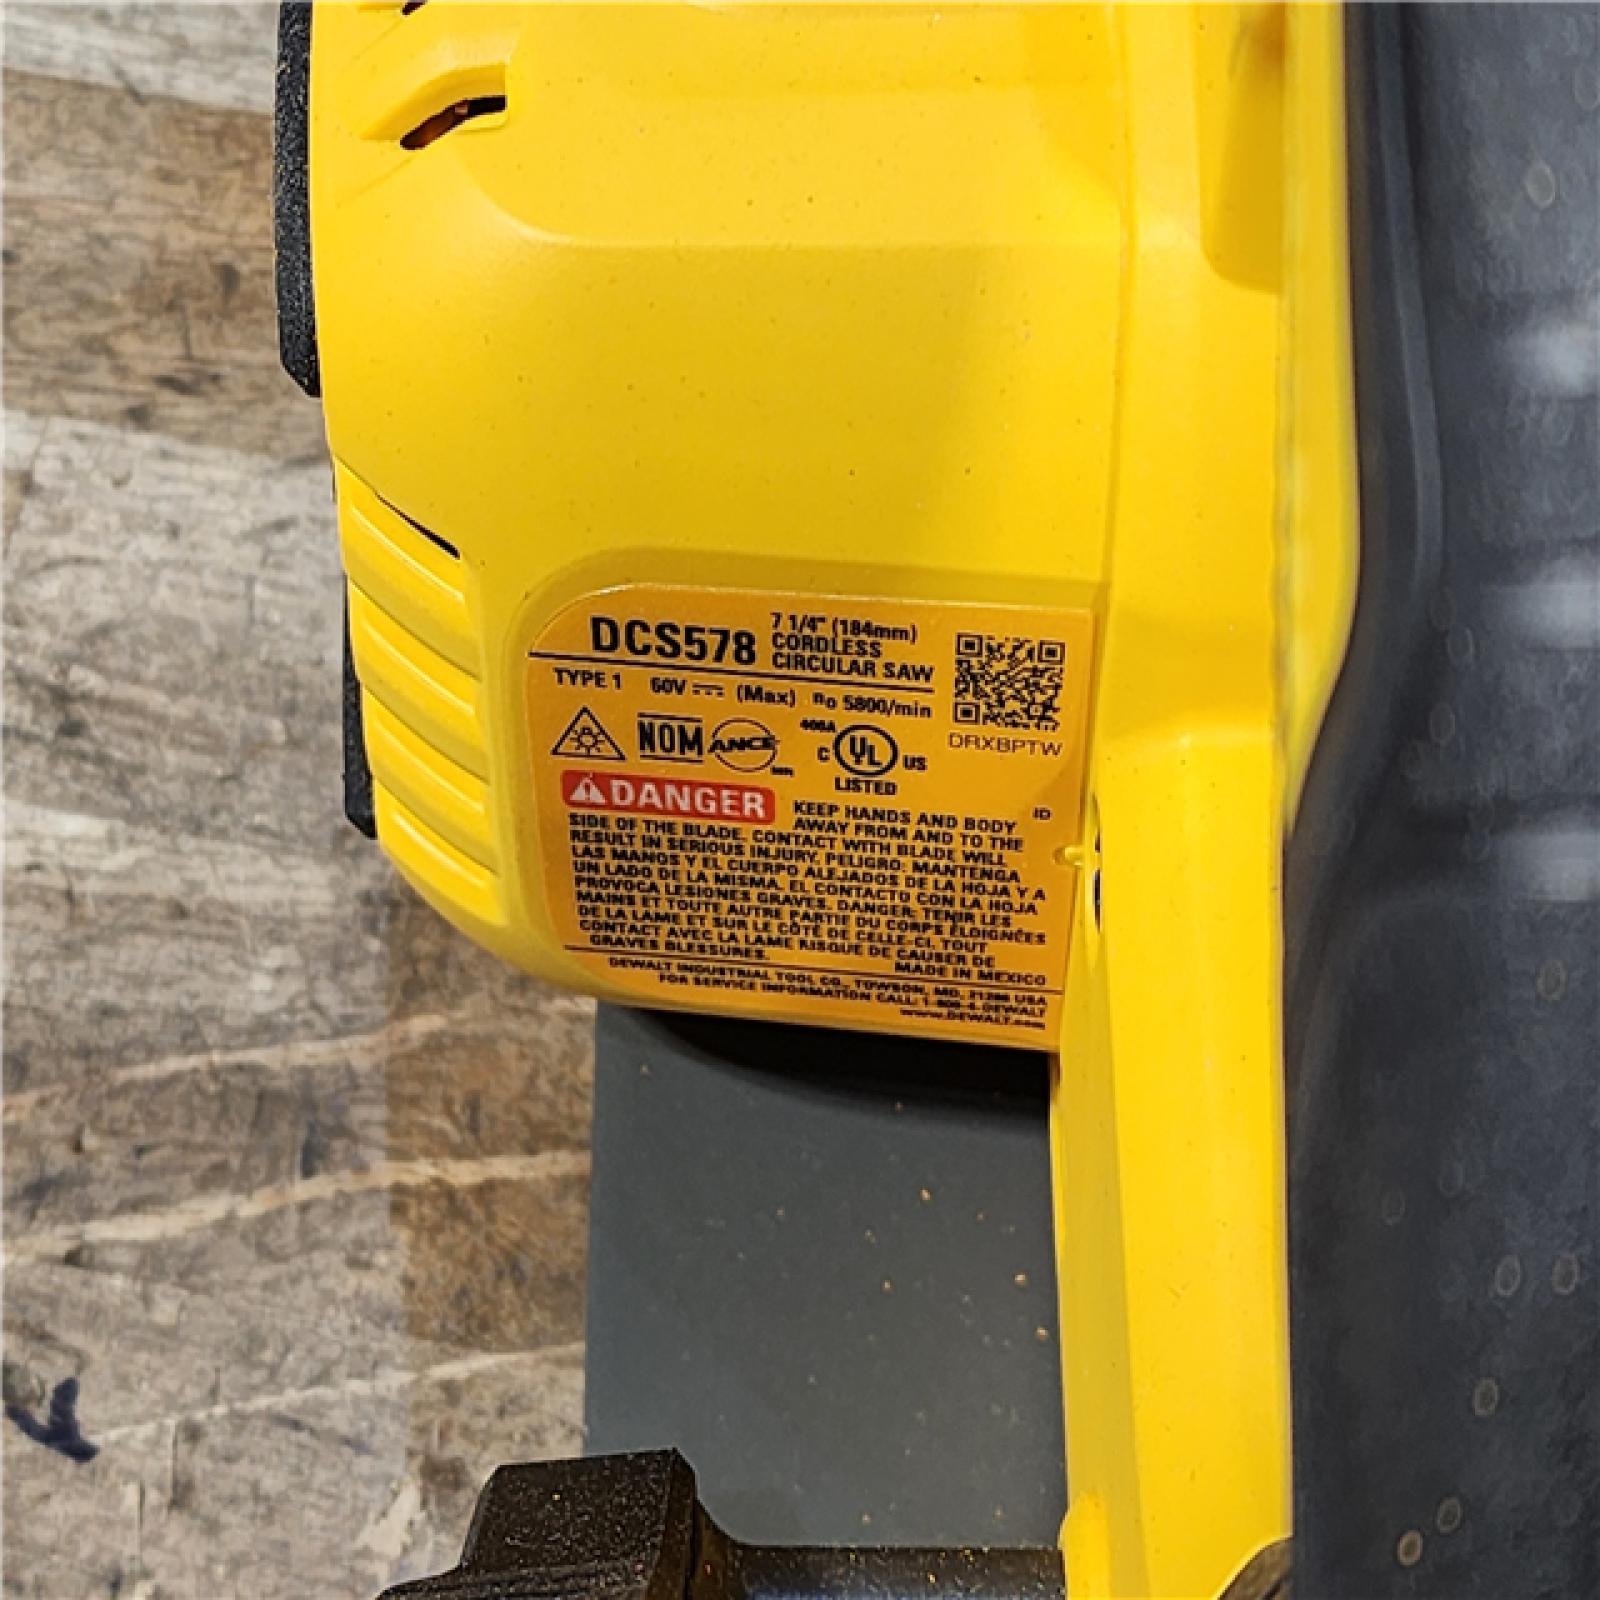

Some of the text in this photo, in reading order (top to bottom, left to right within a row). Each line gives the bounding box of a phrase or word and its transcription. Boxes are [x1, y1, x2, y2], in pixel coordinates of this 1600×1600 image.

[592, 615, 755, 663] DCS578
[771, 612, 781, 631] 7
[832, 617, 915, 643] (184mm)
[772, 631, 881, 657] CORDLESS
[772, 651, 934, 682] CIRCULAR SAW
[554, 667, 608, 688] TYPE
[612, 672, 621, 689] 1
[650, 676, 687, 695] 60V
[737, 684, 795, 707] (Max)
[843, 693, 932, 716] 5800/min
[639, 720, 703, 756] NOM
[849, 735, 883, 767] UL
[903, 755, 927, 771] US
[610, 778, 765, 816] DANGER
[835, 776, 897, 796] LISTED
[794, 800, 1017, 833] KEEP HANDS AND BODY
[794, 817, 1023, 850] AWAY FROM AND TO THE
[569, 813, 610, 828] SIDE
[615, 817, 637, 831] OF
[643, 819, 678, 834] THE
[752, 829, 837, 848] CONTACT
[842, 837, 890, 854] WITH
[897, 842, 956, 860] BLADE
[962, 848, 1007, 864] WILL
[570, 829, 635, 845] RESULT
[641, 835, 661, 848] IN
[667, 837, 745, 854] SERIOUS
[912, 860, 1019, 879] MANTENGA
[572, 845, 1045, 899] LAS MANOS Y EL CUERPO ALEJADOS DE LA HOJA Y A
[574, 860, 600, 873] UN
[605, 863, 652, 878] LADO
[659, 868, 680, 880] DE
[687, 870, 708, 883] LA
[789, 879, 811, 892] EL
[815, 882, 911, 901] CONTACTO
[916, 891, 955, 906] CON
[960, 895, 983, 908] LA
[988, 898, 1038, 913] HOJA
[575, 875, 660, 893] PROVOCA
[665, 883, 751, 901] LESIONES
[980, 912, 1011, 926] LES
[576, 890, 635, 905] MAINS
[641, 896, 661, 908] ET
[666, 898, 720, 913] TOUTE
[727, 904, 781, 919] AUTRE
[789, 909, 847, 925] PARTIE
[857, 916, 880, 928] DU
[887, 918, 943, 934] CORPS
[578, 904, 600, 916] DE
[605, 907, 626, 919] LA
[632, 909, 680, 923] LAME
[687, 914, 706, 926] ET
[713, 916, 746, 930] SUR
[752, 920, 770, 932] LE
[827, 927, 846, 940] DE
[940, 937, 987, 953] TOUT
[580, 918, 660, 935] CONTACT
[667, 926, 713, 940] AVEC
[718, 931, 737, 943] LA
[744, 933, 793, 948] LAME
[869, 945, 891, 957] DE
[897, 947, 966, 964] CAUSER
[972, 954, 995, 966] DE
[589, 933, 658, 949] GRAVES
[609, 957, 671, 971] DEWALT
[894, 961, 1045, 985] MADE IN MEXICO
